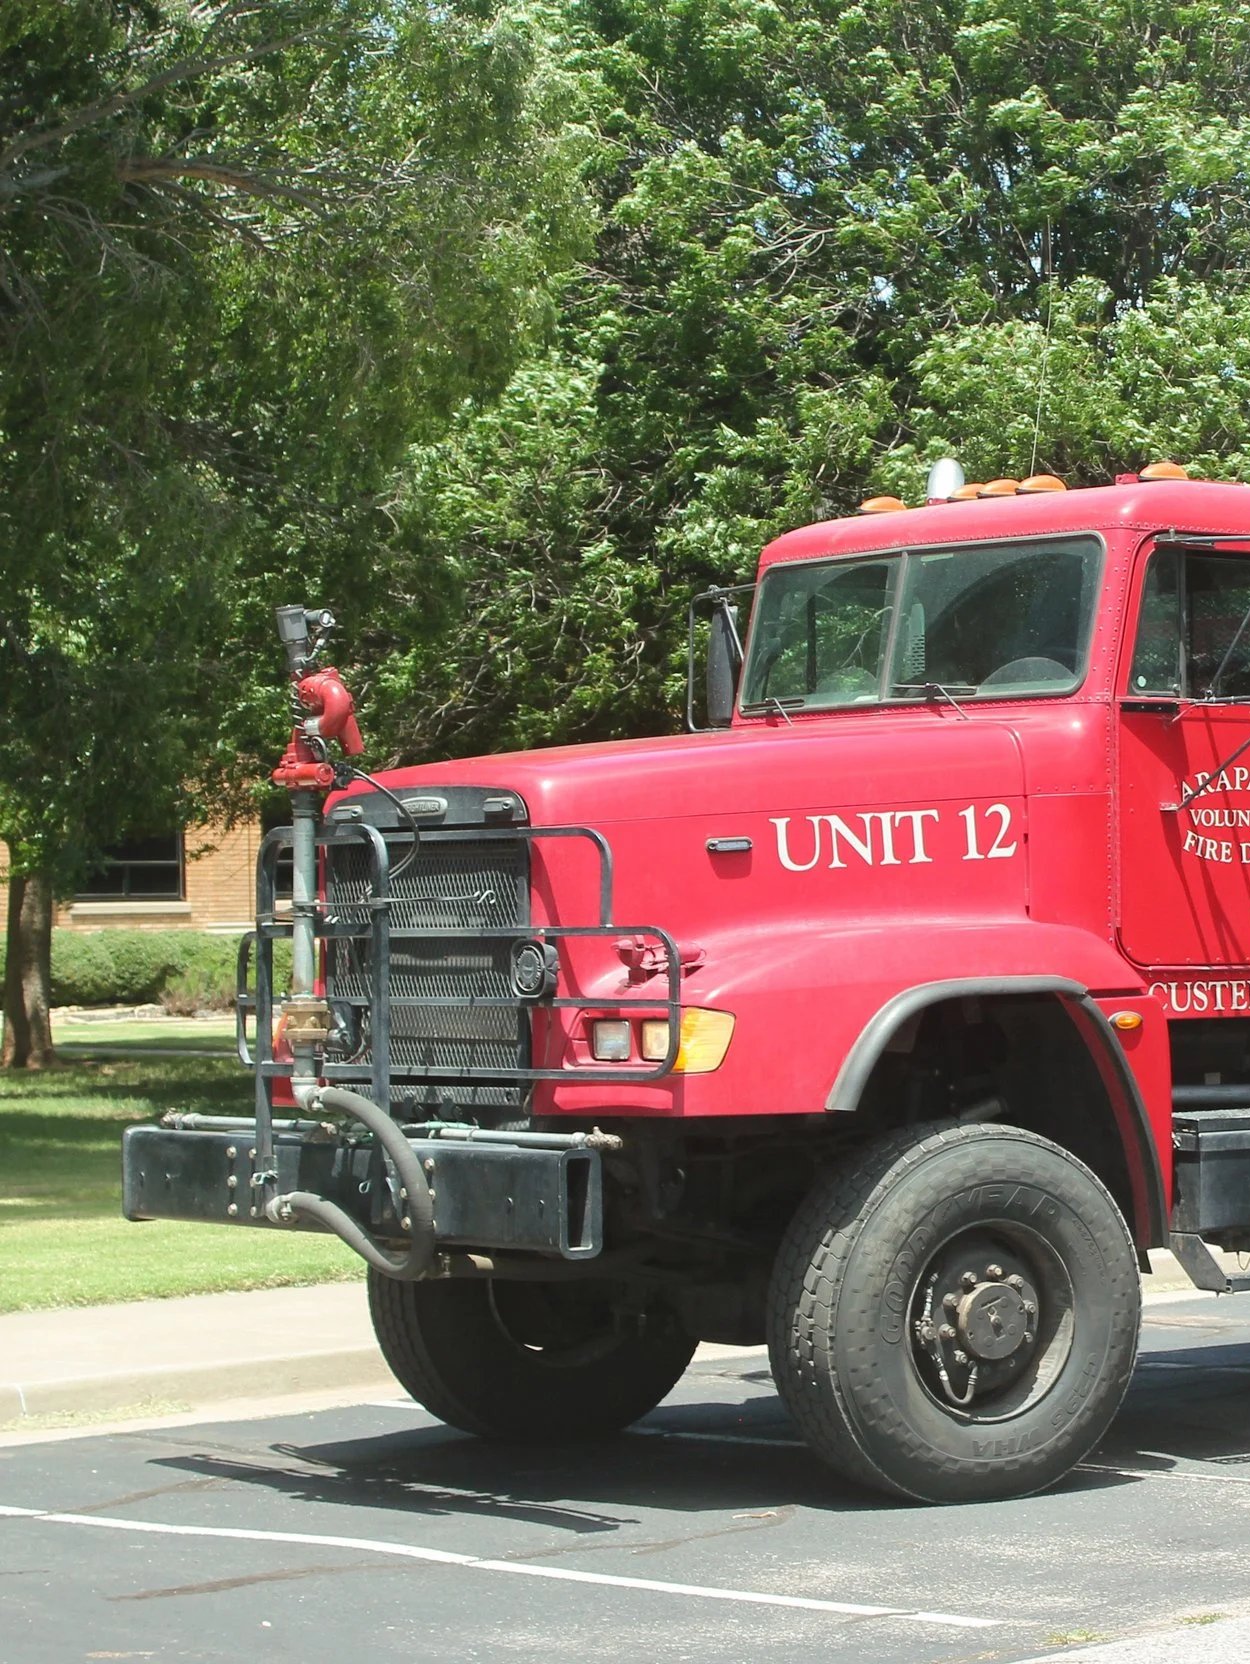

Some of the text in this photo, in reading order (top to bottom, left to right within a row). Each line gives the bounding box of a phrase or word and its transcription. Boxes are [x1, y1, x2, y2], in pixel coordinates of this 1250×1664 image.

[768, 803, 1018, 872] UNIT 12
[1183, 829, 1232, 863] FIRE
[880, 1182, 1061, 1344] GOODYEAR
